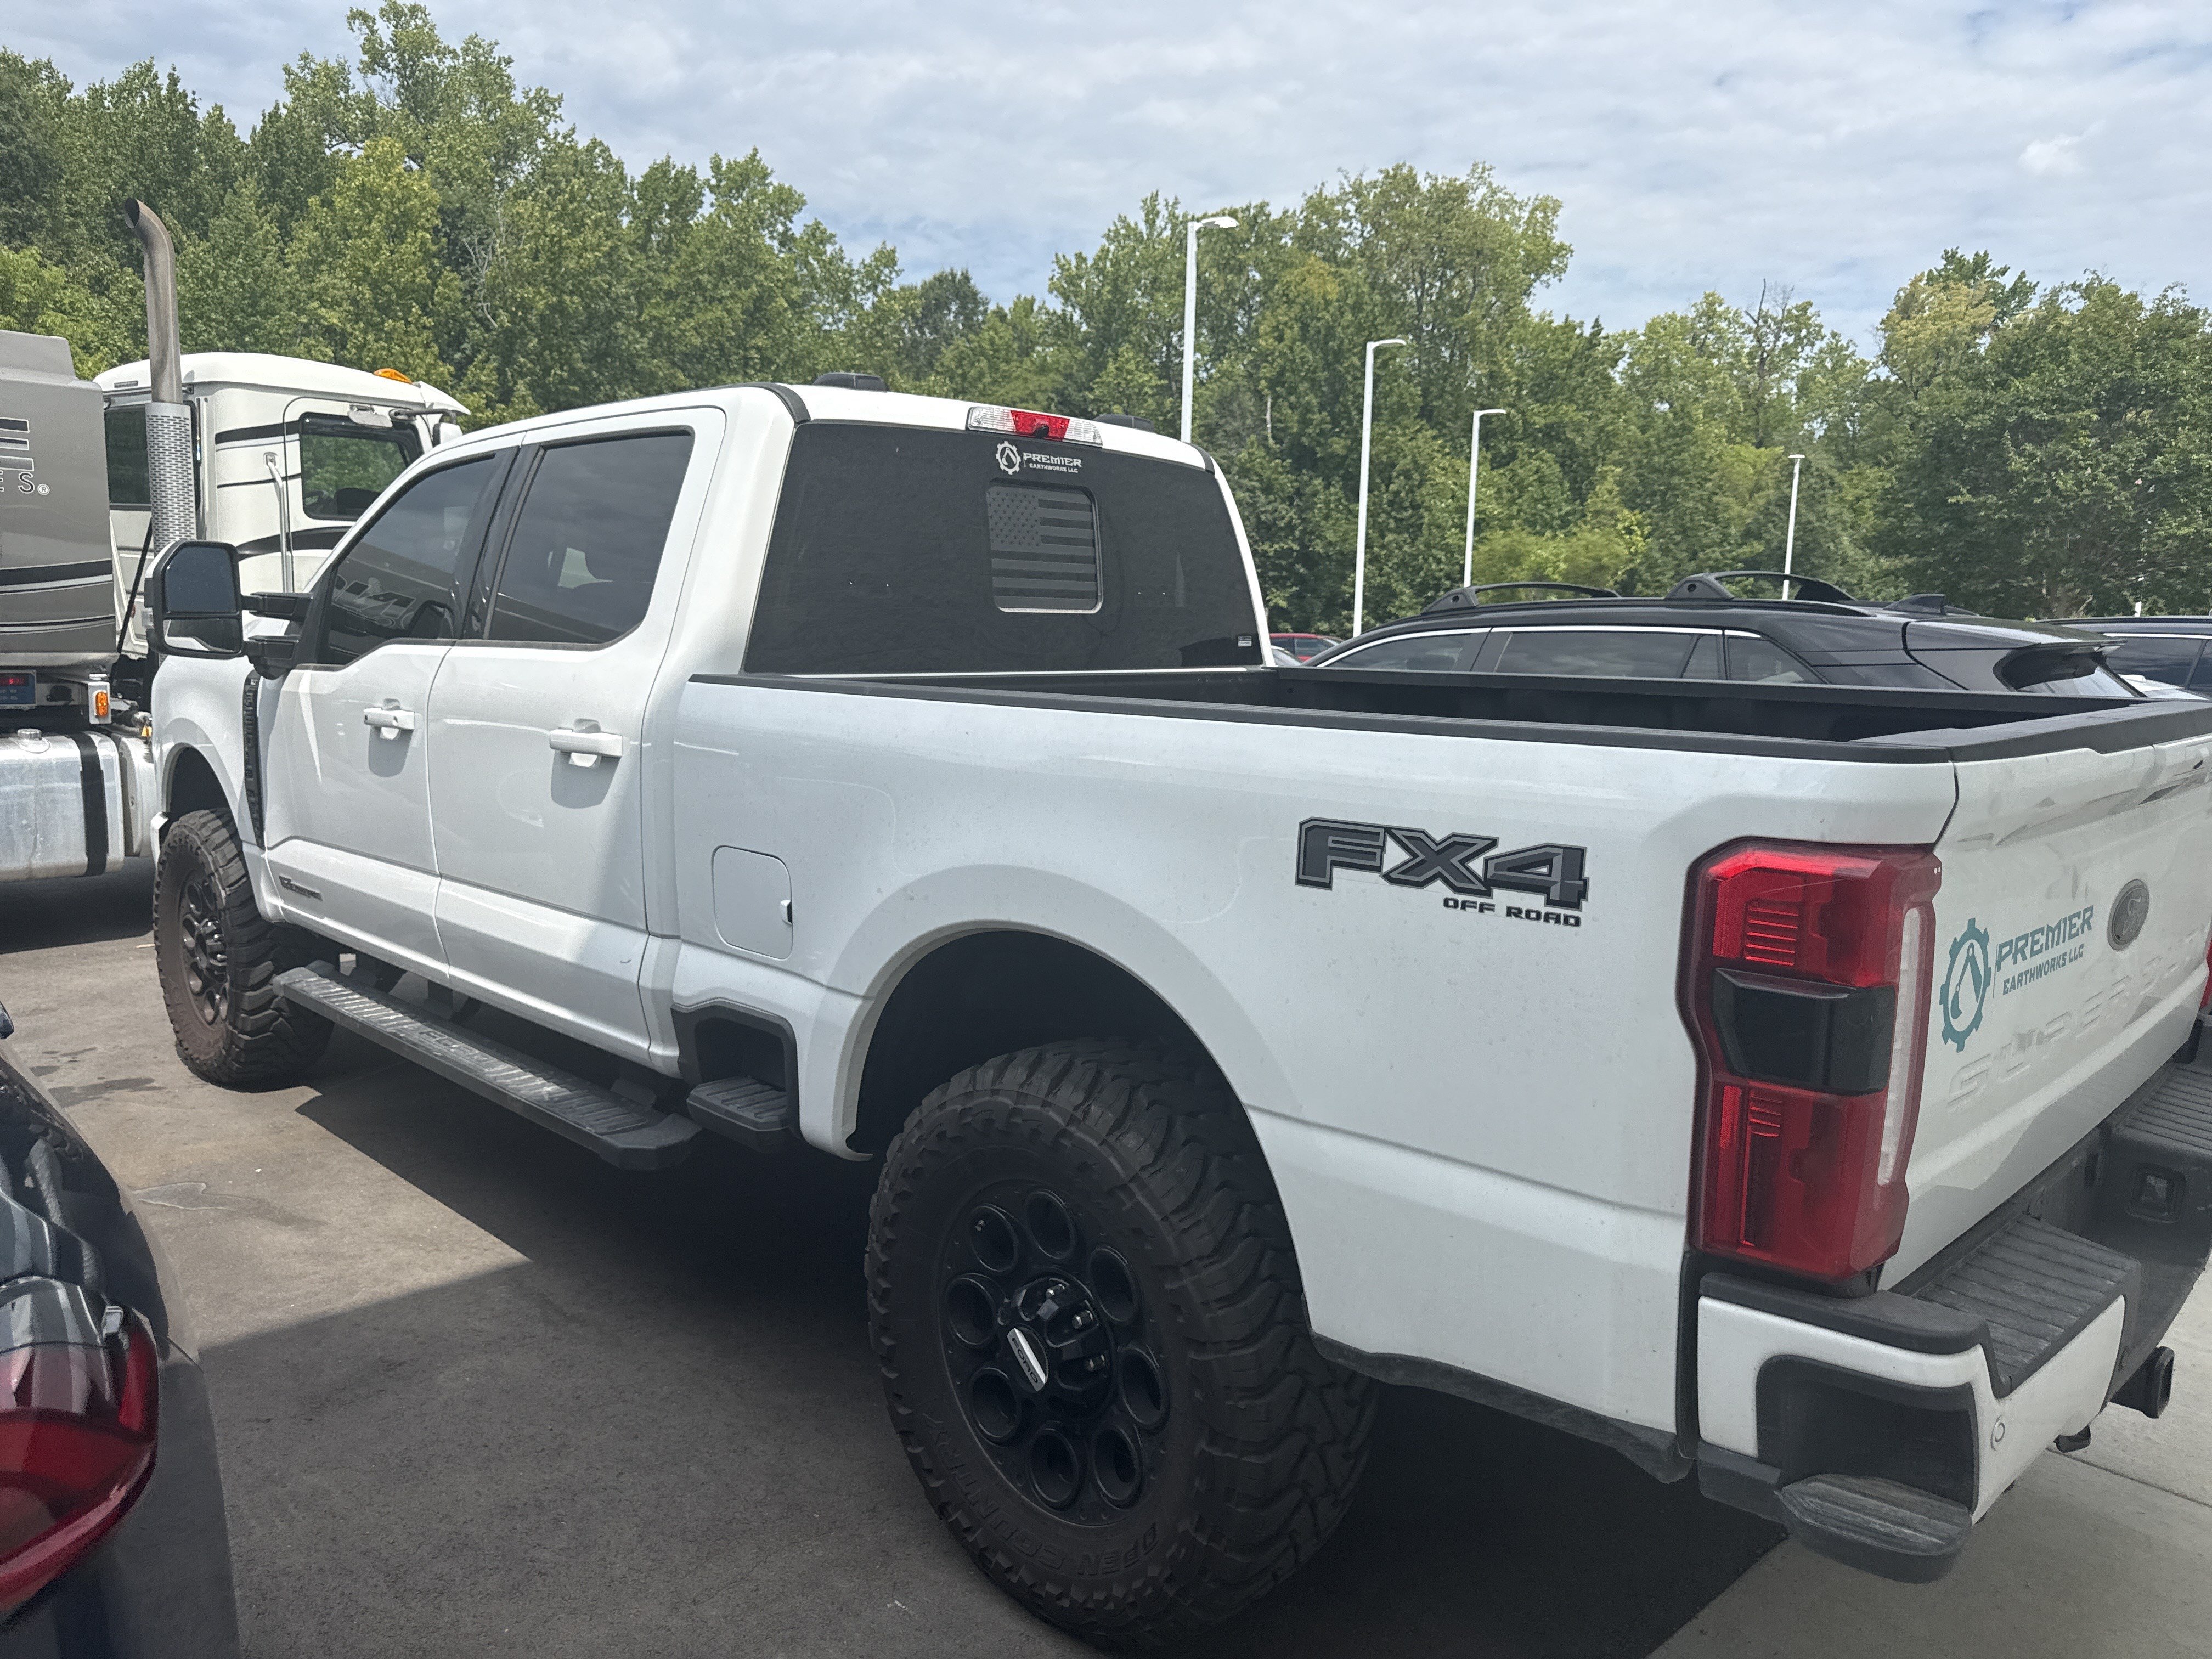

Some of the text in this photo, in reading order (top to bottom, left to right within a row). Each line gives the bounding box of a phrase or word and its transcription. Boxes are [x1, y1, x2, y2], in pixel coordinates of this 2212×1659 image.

[1024, 453, 1082, 467] PREMIER
[1029, 463, 1067, 472] EARTHWORKS
[1295, 817, 1589, 912] FX4
[1443, 896, 1582, 928] OFF ROAD
[1996, 905, 2094, 972] PREMIER
[2002, 943, 2085, 996] EARTHWORKS LLC
[1077, 1522, 1160, 1577] OPEN
